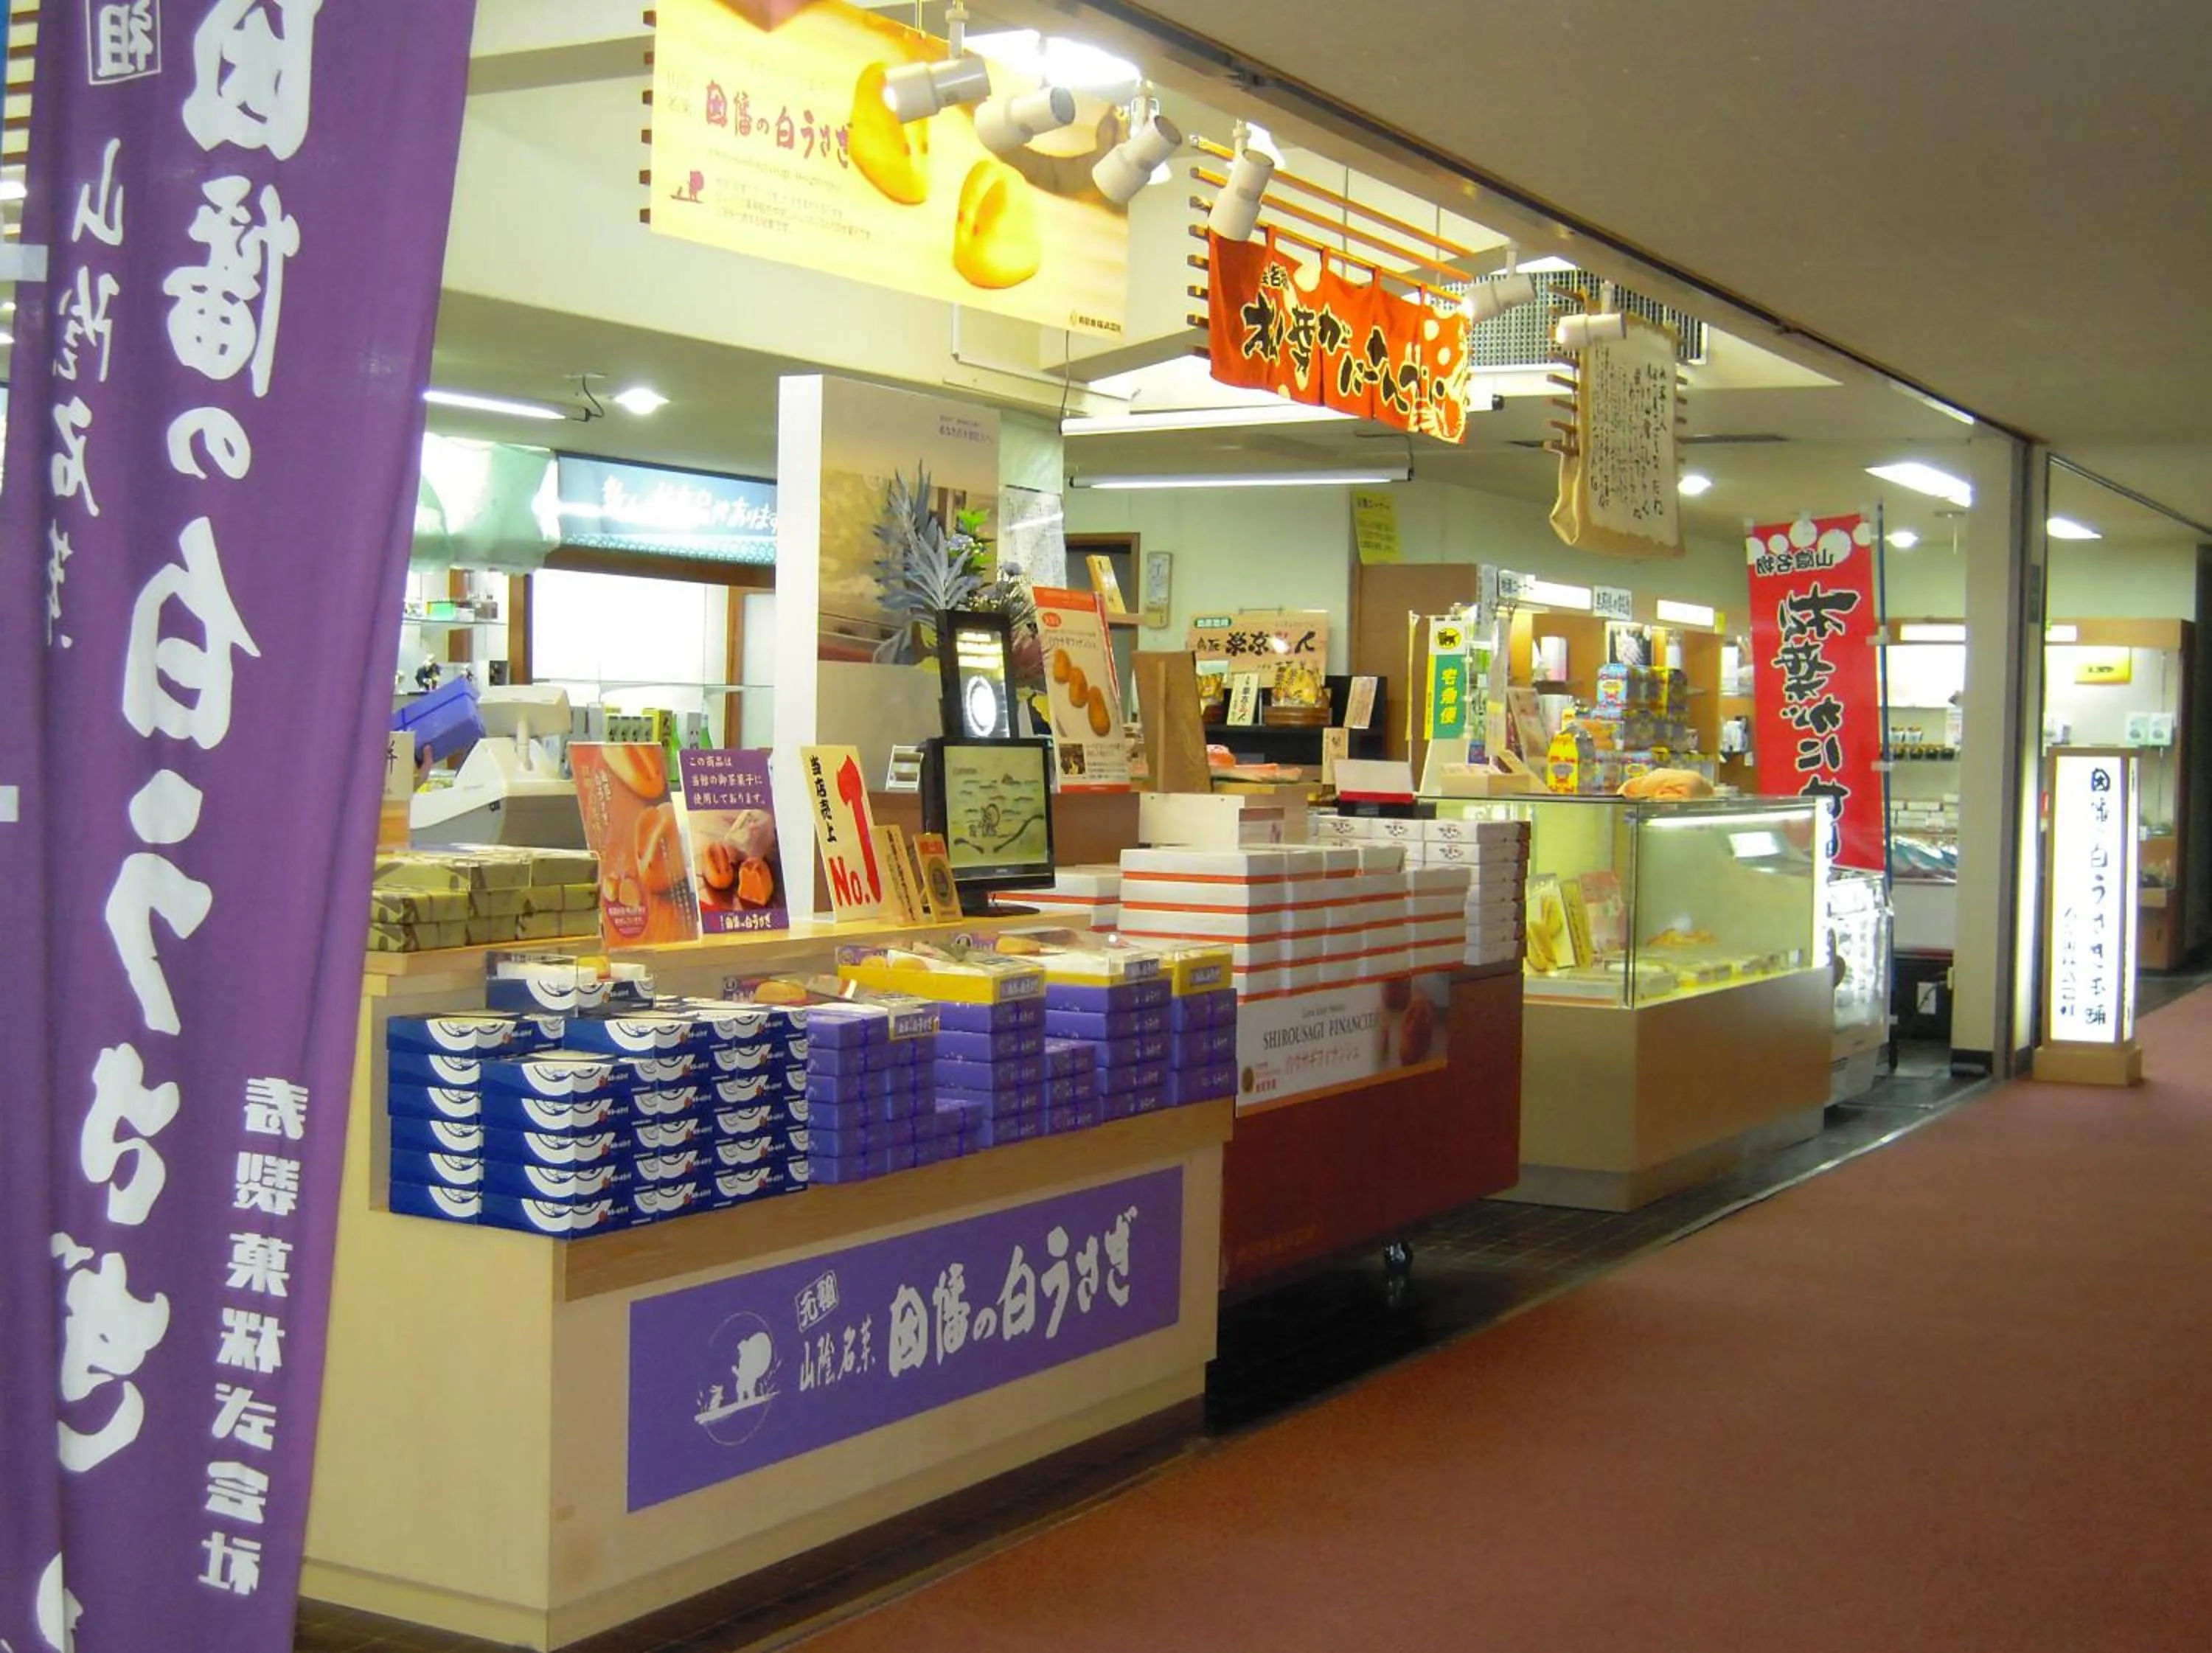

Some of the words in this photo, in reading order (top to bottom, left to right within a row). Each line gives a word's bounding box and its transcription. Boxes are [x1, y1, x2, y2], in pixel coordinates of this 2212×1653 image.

[706, 79, 854, 170] 因幡の白うさぎ
[888, 1205, 1138, 1378] 因幡の白うさぎ
[799, 1315, 876, 1393] 山陰名菓
